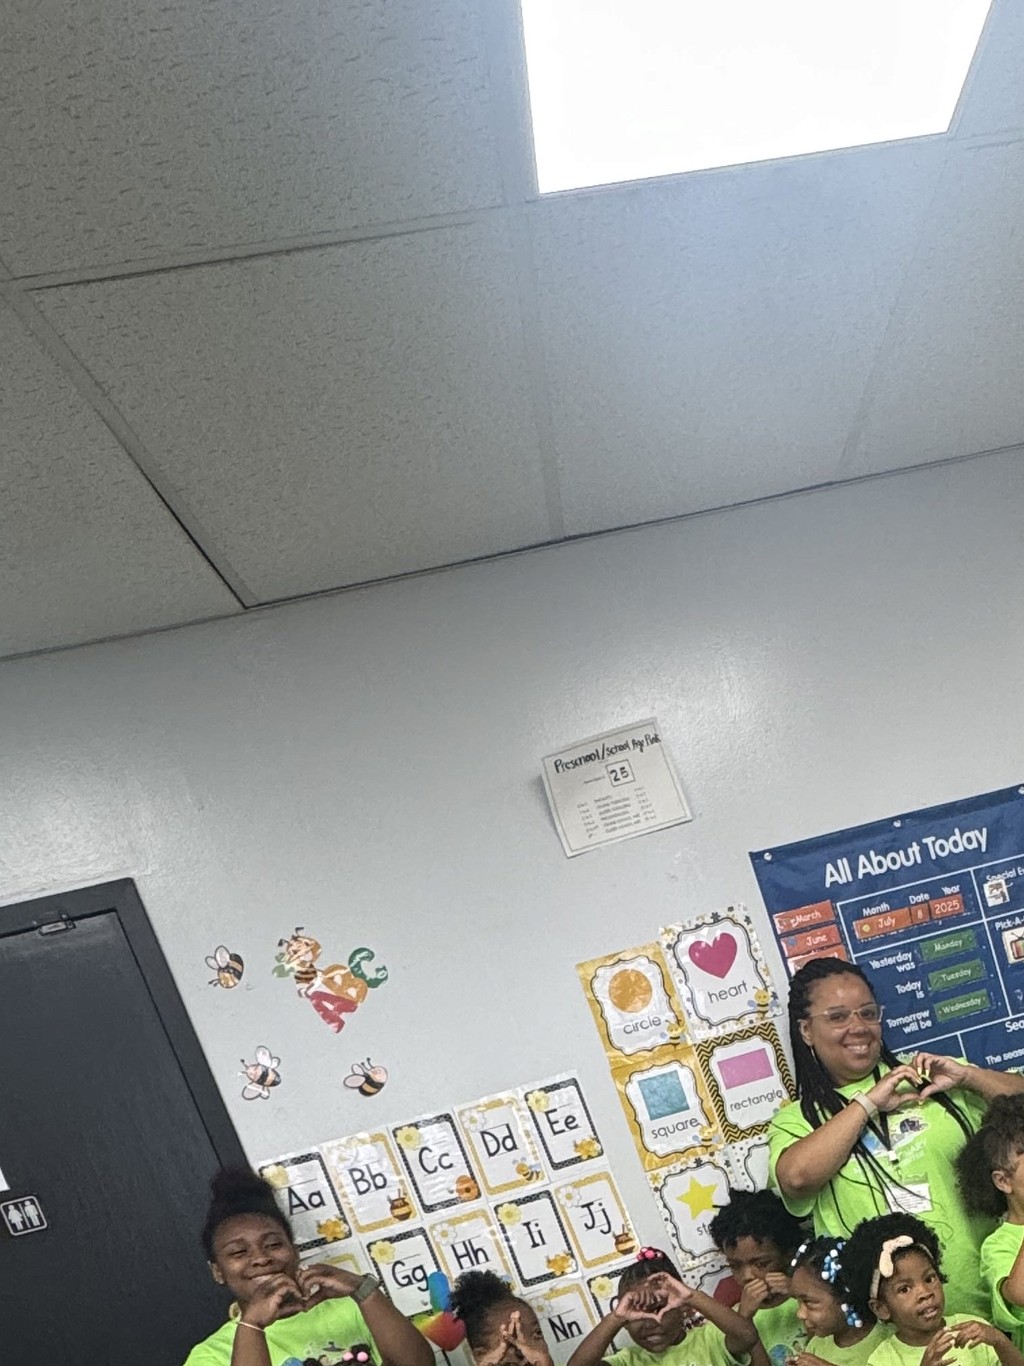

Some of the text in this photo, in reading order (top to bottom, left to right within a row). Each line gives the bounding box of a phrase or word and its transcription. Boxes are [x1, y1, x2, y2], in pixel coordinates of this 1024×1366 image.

[610, 767, 629, 782] 25
[825, 827, 987, 888] All About Today
[941, 884, 960, 896] Year
[909, 893, 930, 905] Date
[862, 903, 890, 917] Month
[877, 916, 897, 929] July
[934, 900, 960, 914] 2025
[806, 934, 827, 946] June
[934, 939, 963, 952] Monday
[869, 951, 912, 970] Yesterday
[896, 961, 916, 973] was
[941, 968, 971, 982] Tuesday
[708, 981, 748, 1005] heart
[895, 980, 922, 994] Today
[942, 997, 981, 1014] Wednesday
[623, 1015, 661, 1035] circle
[886, 1009, 930, 1028] Tomorrow
[903, 1019, 932, 1034] will be
[985, 1055, 1002, 1066] The
[730, 1089, 783, 1112] rectangle
[651, 1117, 699, 1140] square
[287, 1108, 579, 1215] Aa Bb Cc Dd Ee
[391, 1202, 612, 1292] Gg Hh Ii Jj
[548, 1314, 584, 1343] Nn
